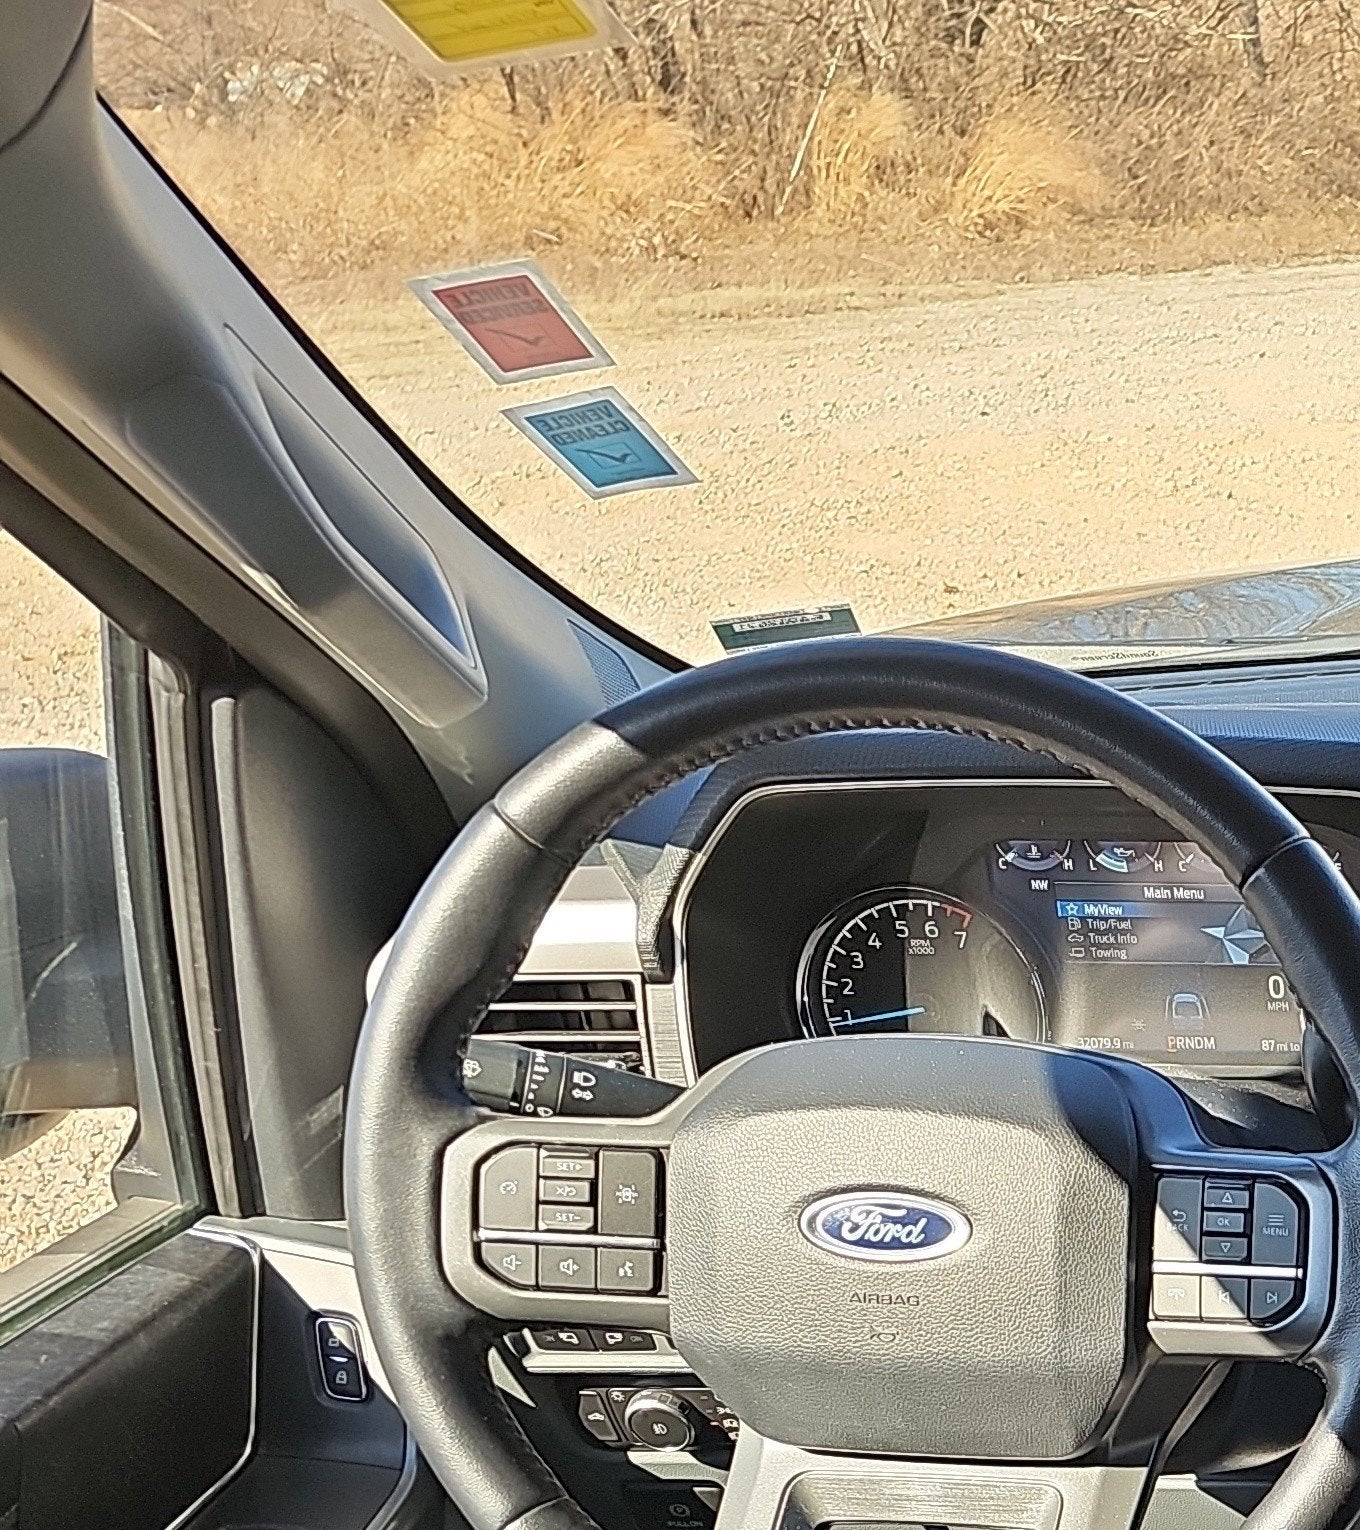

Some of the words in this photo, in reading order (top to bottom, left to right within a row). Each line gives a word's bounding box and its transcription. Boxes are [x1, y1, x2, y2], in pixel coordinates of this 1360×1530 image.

[1030, 880, 1049, 891] NW
[1143, 887, 1171, 899] Main
[1173, 887, 1205, 900] Menu
[1084, 904, 1123, 917] MyView
[895, 920, 909, 938] 5
[924, 920, 939, 938] 6
[1086, 918, 1133, 932] Trip/Fuel
[868, 932, 882, 950] 4
[910, 938, 931, 947] RPM
[954, 932, 967, 948] 7
[1088, 933, 1115, 945] Truck
[1116, 933, 1138, 945] Info
[1090, 946, 1128, 960] Towing
[850, 953, 864, 969] 3
[840, 978, 855, 995] 2
[1268, 975, 1285, 999] 0
[1267, 1001, 1289, 1012] MPH
[1261, 1040, 1275, 1051] 87
[1276, 1041, 1290, 1051] mi
[841, 1205, 928, 1244] Ford
[1216, 1218, 1230, 1227] OK
[1262, 1227, 1289, 1237] MENU
[850, 1291, 920, 1307] AIRBAG
